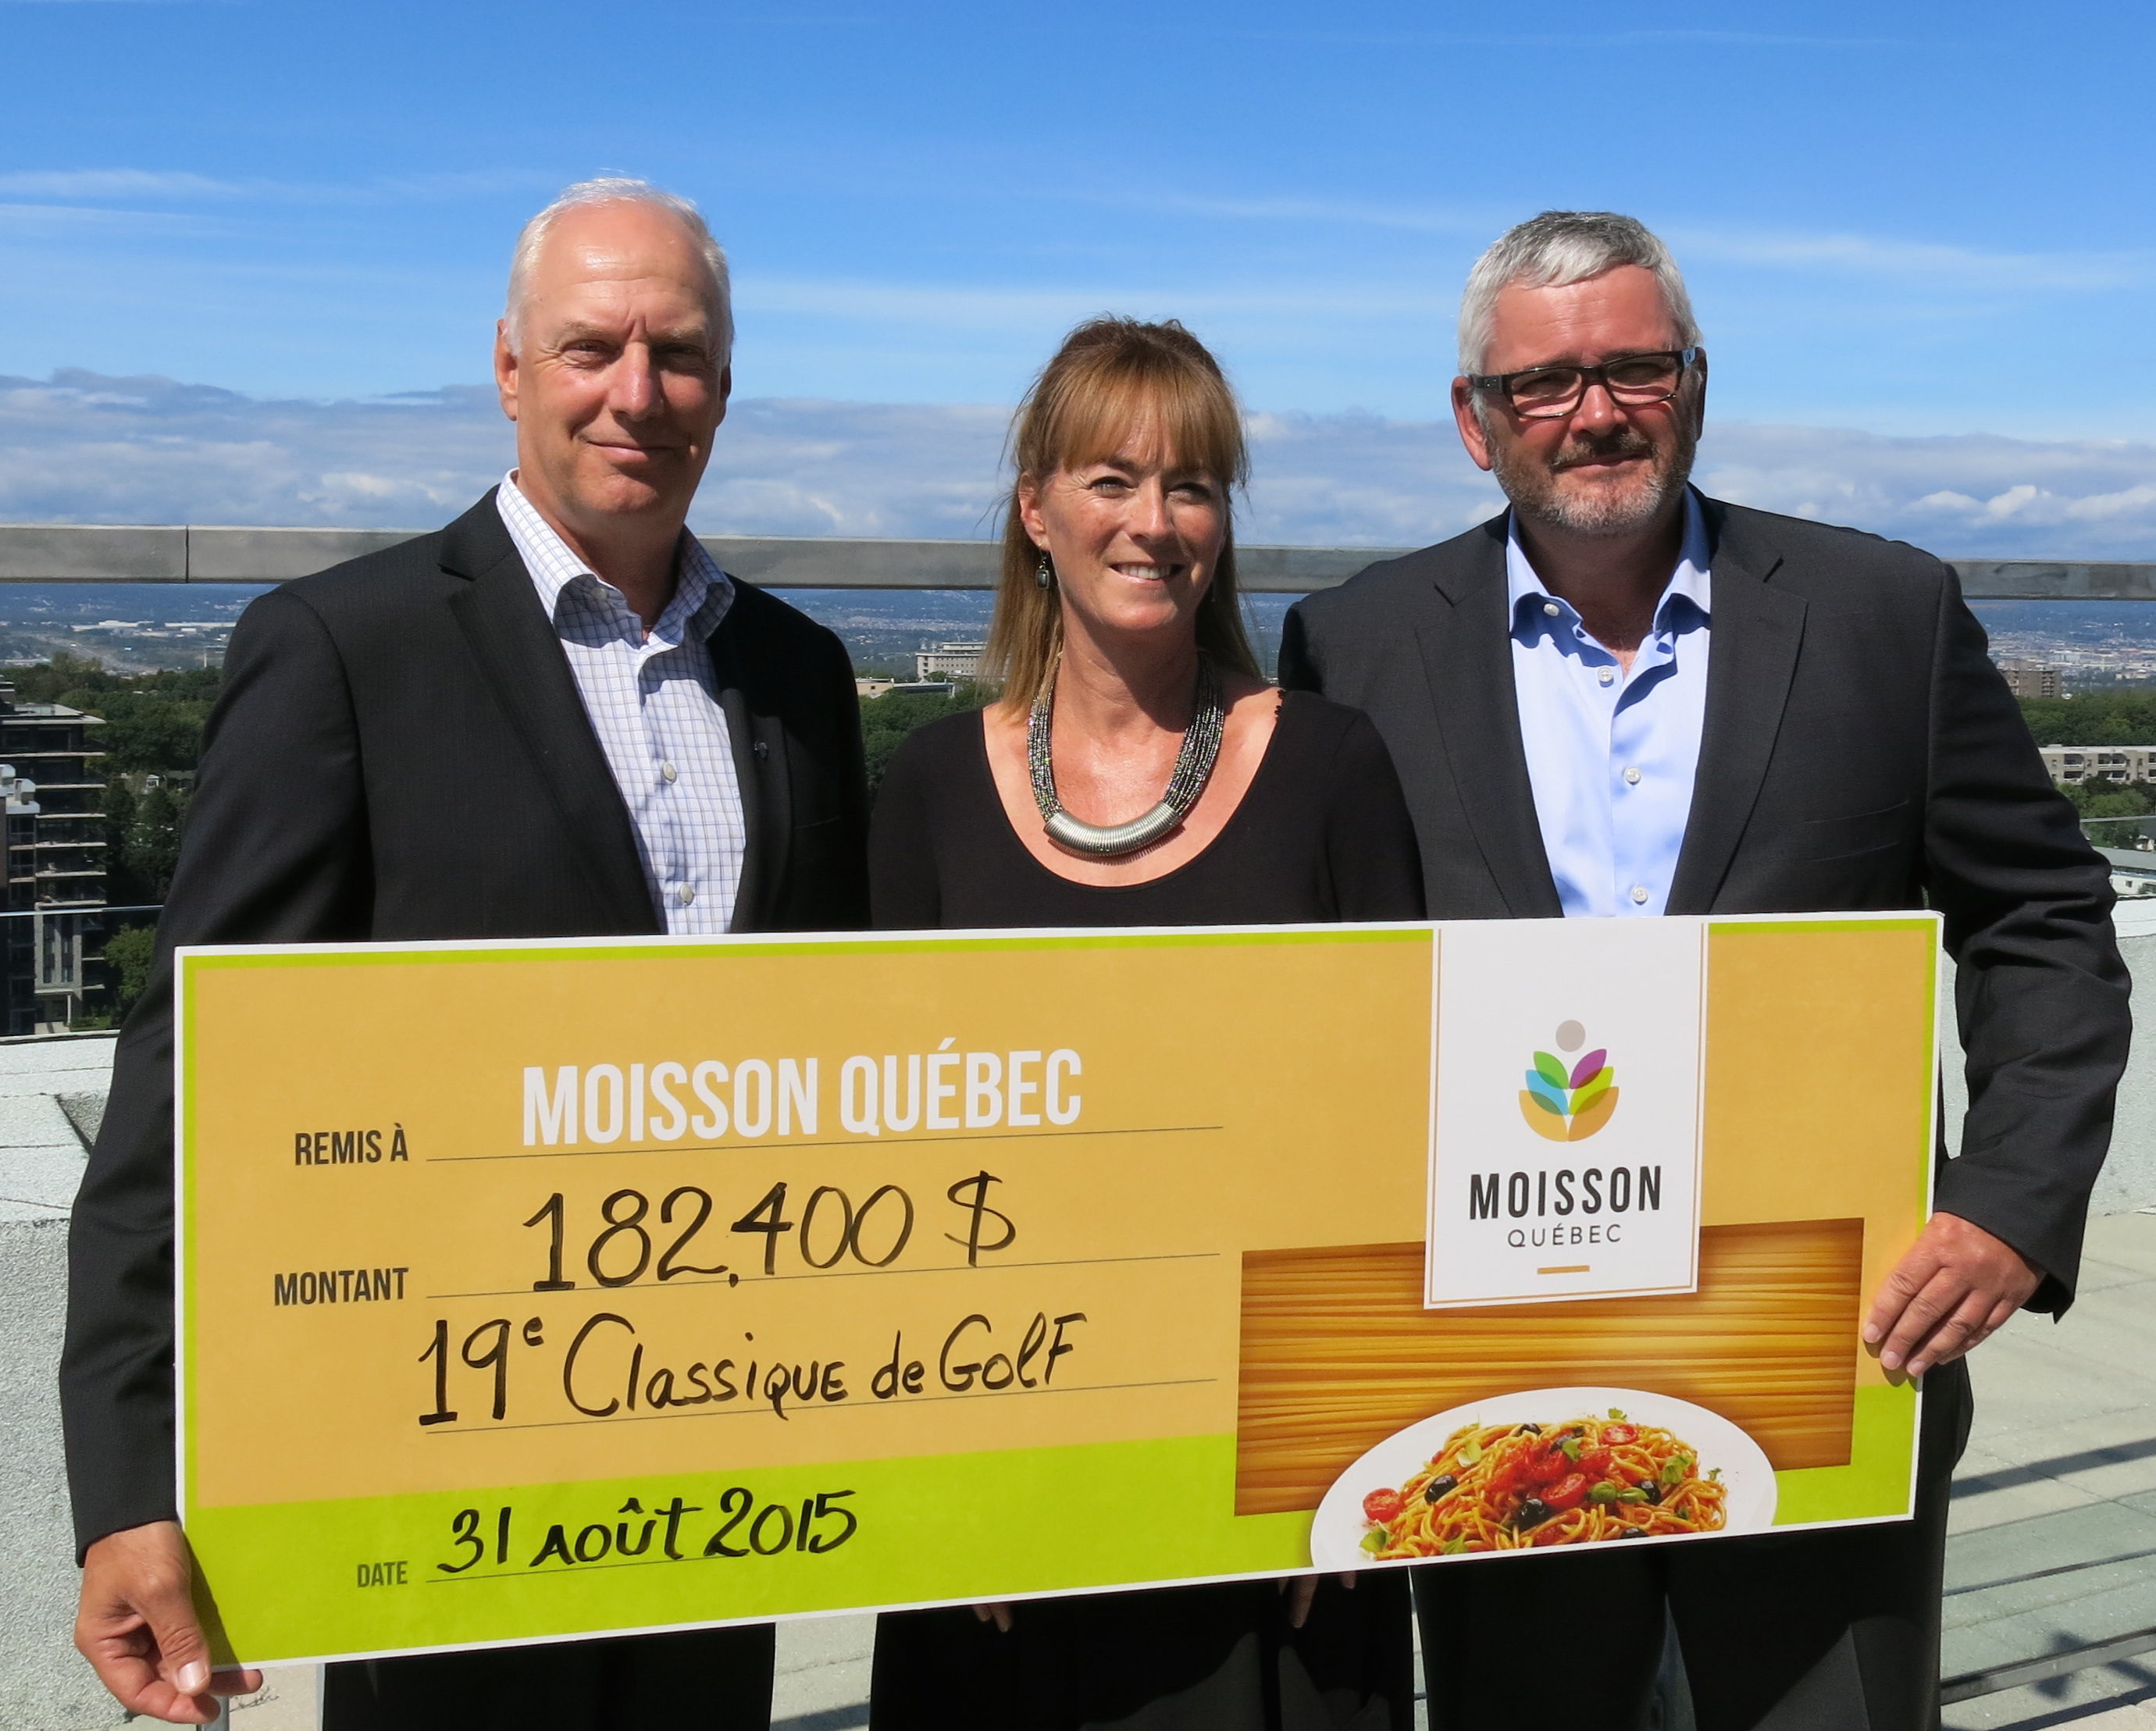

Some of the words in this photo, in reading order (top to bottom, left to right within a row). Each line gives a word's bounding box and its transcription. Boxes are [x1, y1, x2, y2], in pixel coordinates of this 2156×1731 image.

[522, 1056, 819, 1146] MOISSON
[839, 1036, 1083, 1137] QUÉBEC
[294, 1130, 383, 1166] REMIS
[390, 1122, 409, 1162] À
[1469, 1165, 1662, 1220] MOISSON
[522, 1181, 914, 1292] 182,400
[943, 1170, 1017, 1268] $
[1507, 1223, 1622, 1248] QUÉBEC
[273, 1267, 409, 1306] MONTANT
[871, 1330, 925, 1400] de
[437, 1505, 512, 1573] 31
[704, 1487, 857, 1558] 2015
[357, 1561, 408, 1588] DATE
